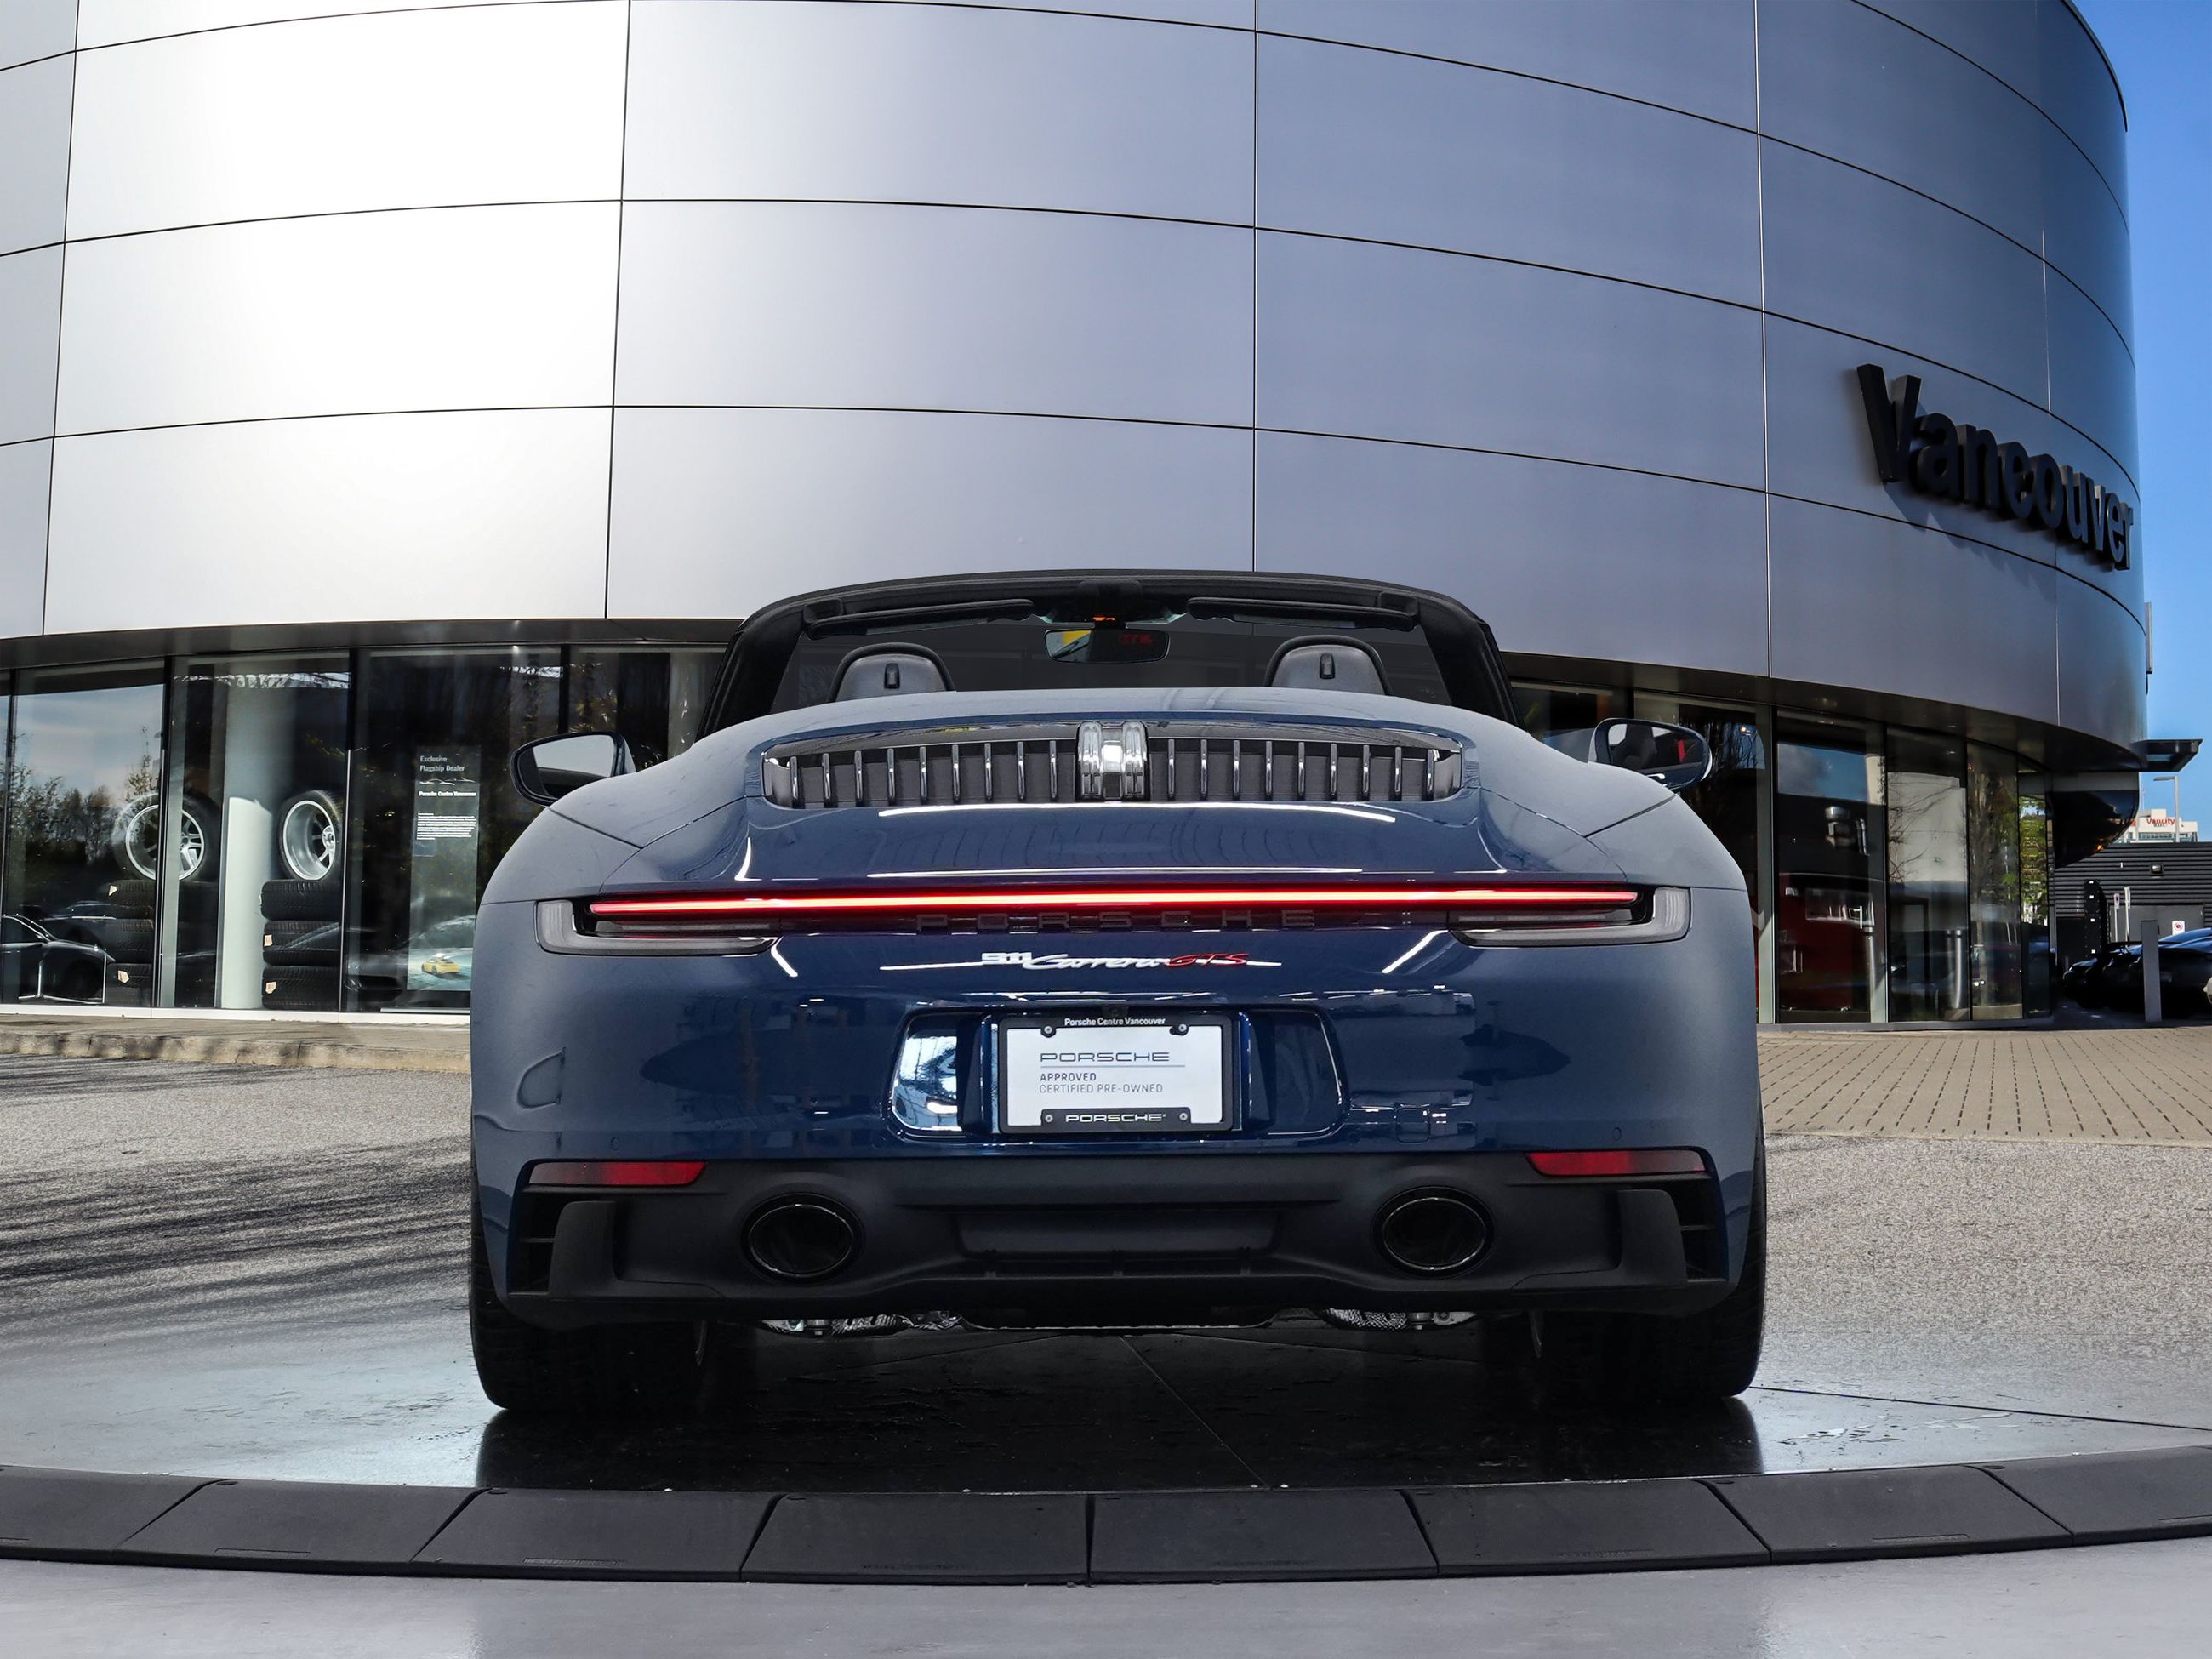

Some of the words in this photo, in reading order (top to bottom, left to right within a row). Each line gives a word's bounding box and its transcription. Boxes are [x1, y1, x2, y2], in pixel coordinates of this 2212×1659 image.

[1856, 363, 2134, 571] Vancouver
[916, 909, 1314, 932] PORSCHE
[1097, 1018, 1124, 1026] Centre
[1040, 1052, 1170, 1062] PORSCHE
[1040, 1073, 1097, 1081] APPROVED
[1040, 1084, 1094, 1093] CERTIFIED
[1097, 1084, 1163, 1093] PRE-OWNED
